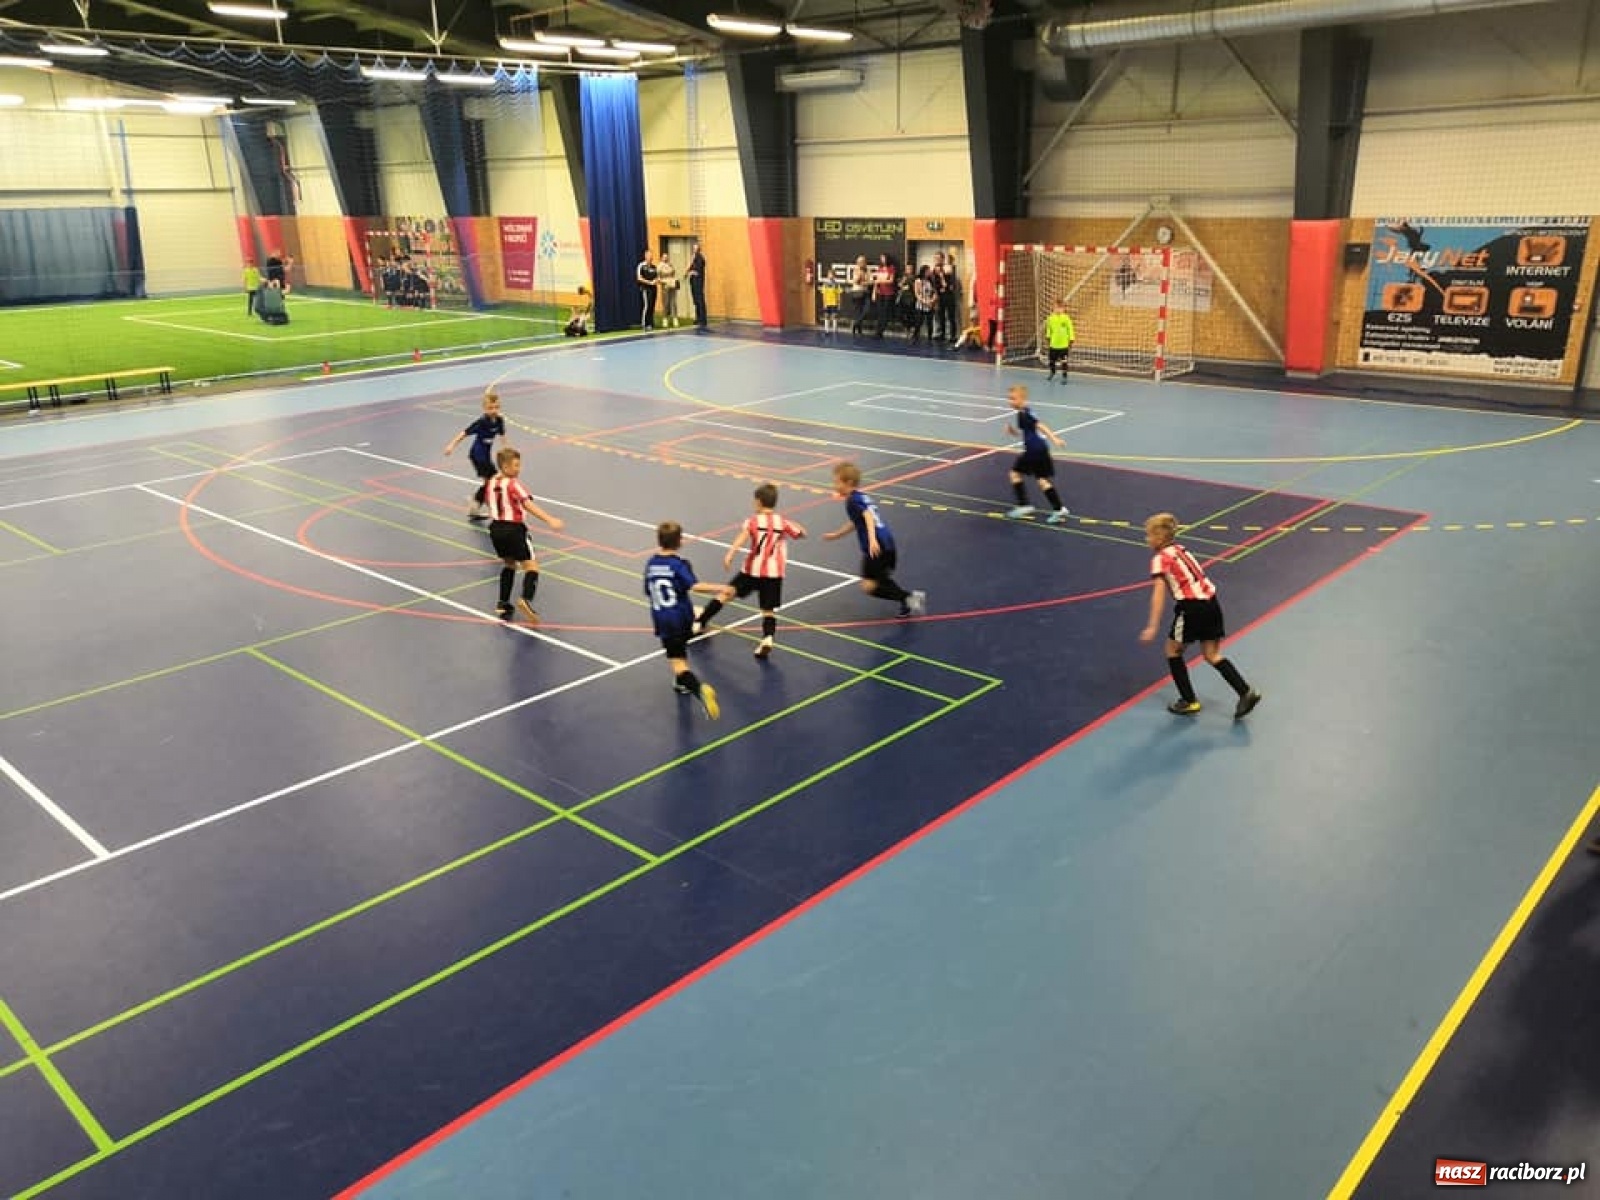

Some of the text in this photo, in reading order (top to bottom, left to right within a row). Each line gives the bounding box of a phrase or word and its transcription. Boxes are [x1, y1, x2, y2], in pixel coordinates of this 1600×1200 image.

[817, 221, 842, 232] LED
[1506, 266, 1572, 276] INTERNET
[1433, 314, 1491, 327] TELEVIZE
[756, 526, 784, 556] 77
[648, 579, 678, 611] 10
